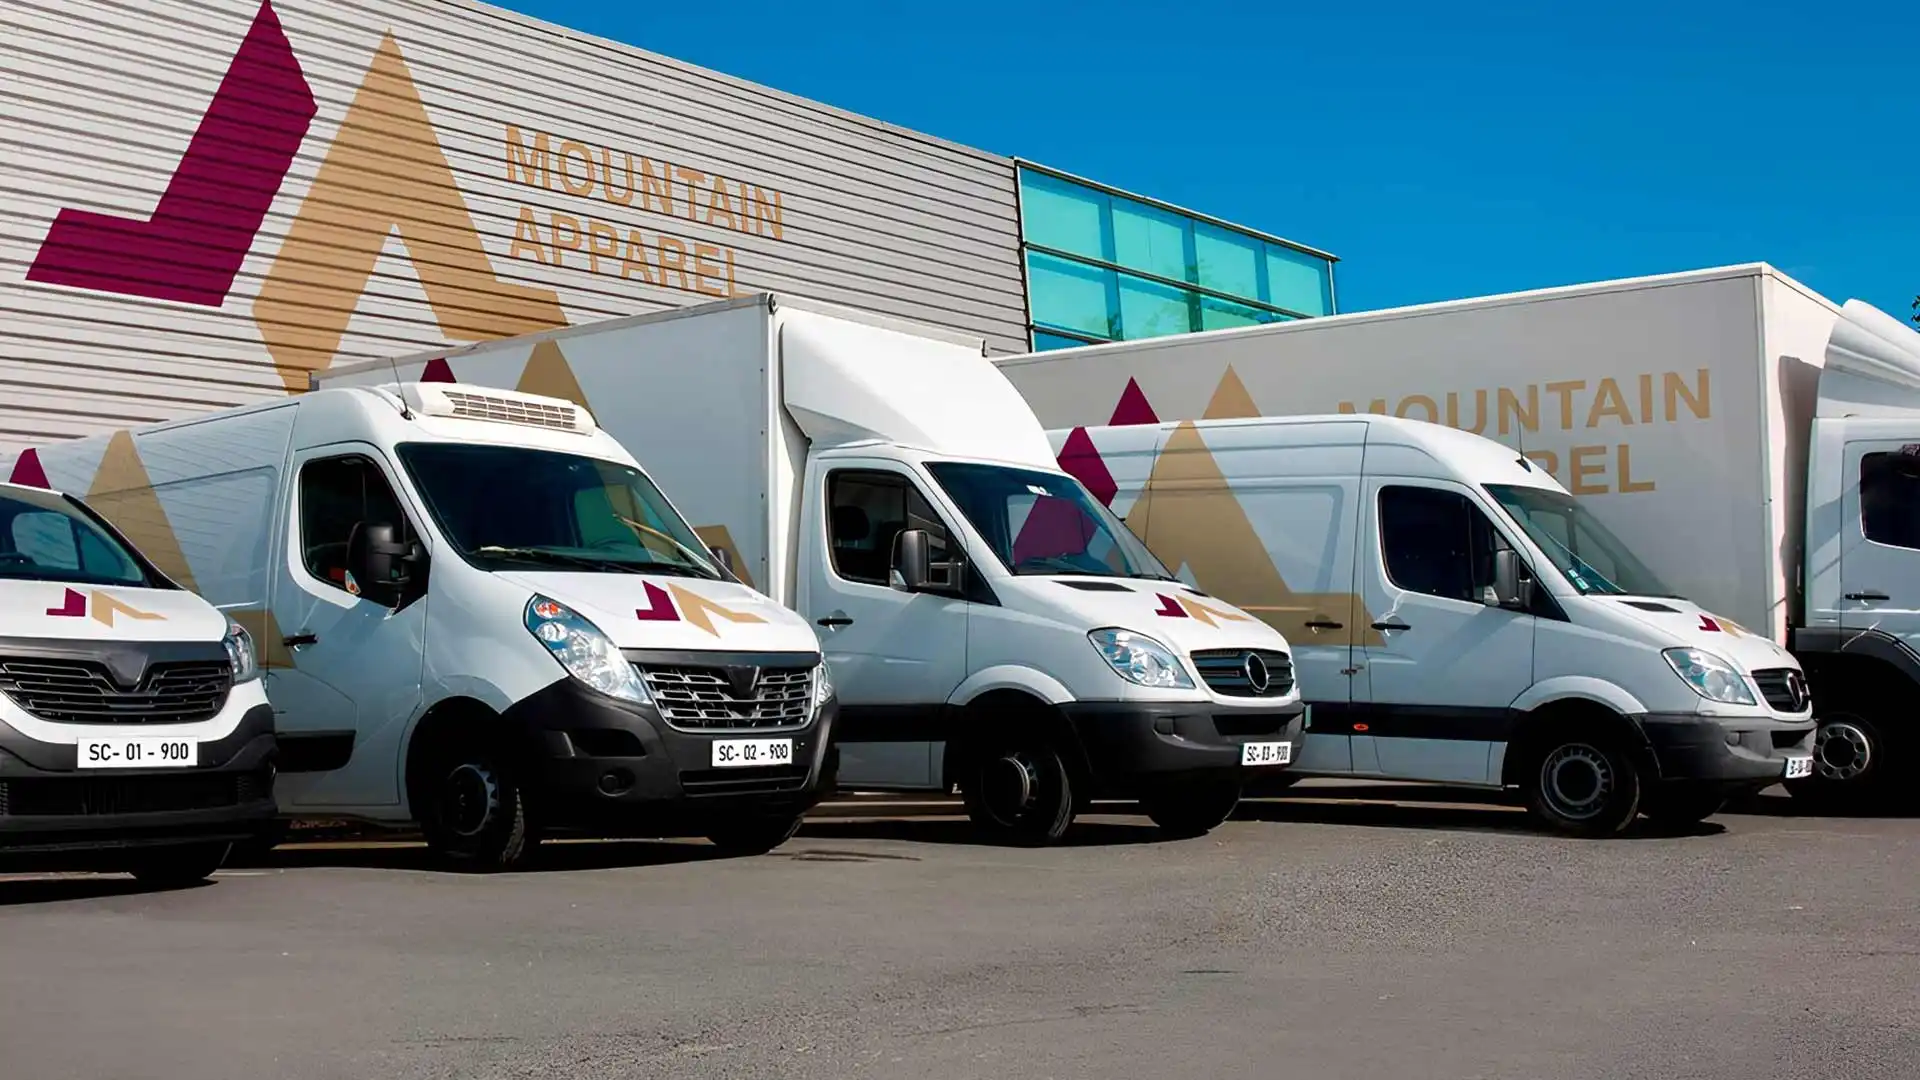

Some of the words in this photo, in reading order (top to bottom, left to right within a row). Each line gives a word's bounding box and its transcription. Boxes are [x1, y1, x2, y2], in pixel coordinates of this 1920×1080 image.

[505, 124, 783, 240] MOUNTAIN
[510, 205, 753, 298] APPAREL
[1338, 369, 1711, 435] OUNTAIN
